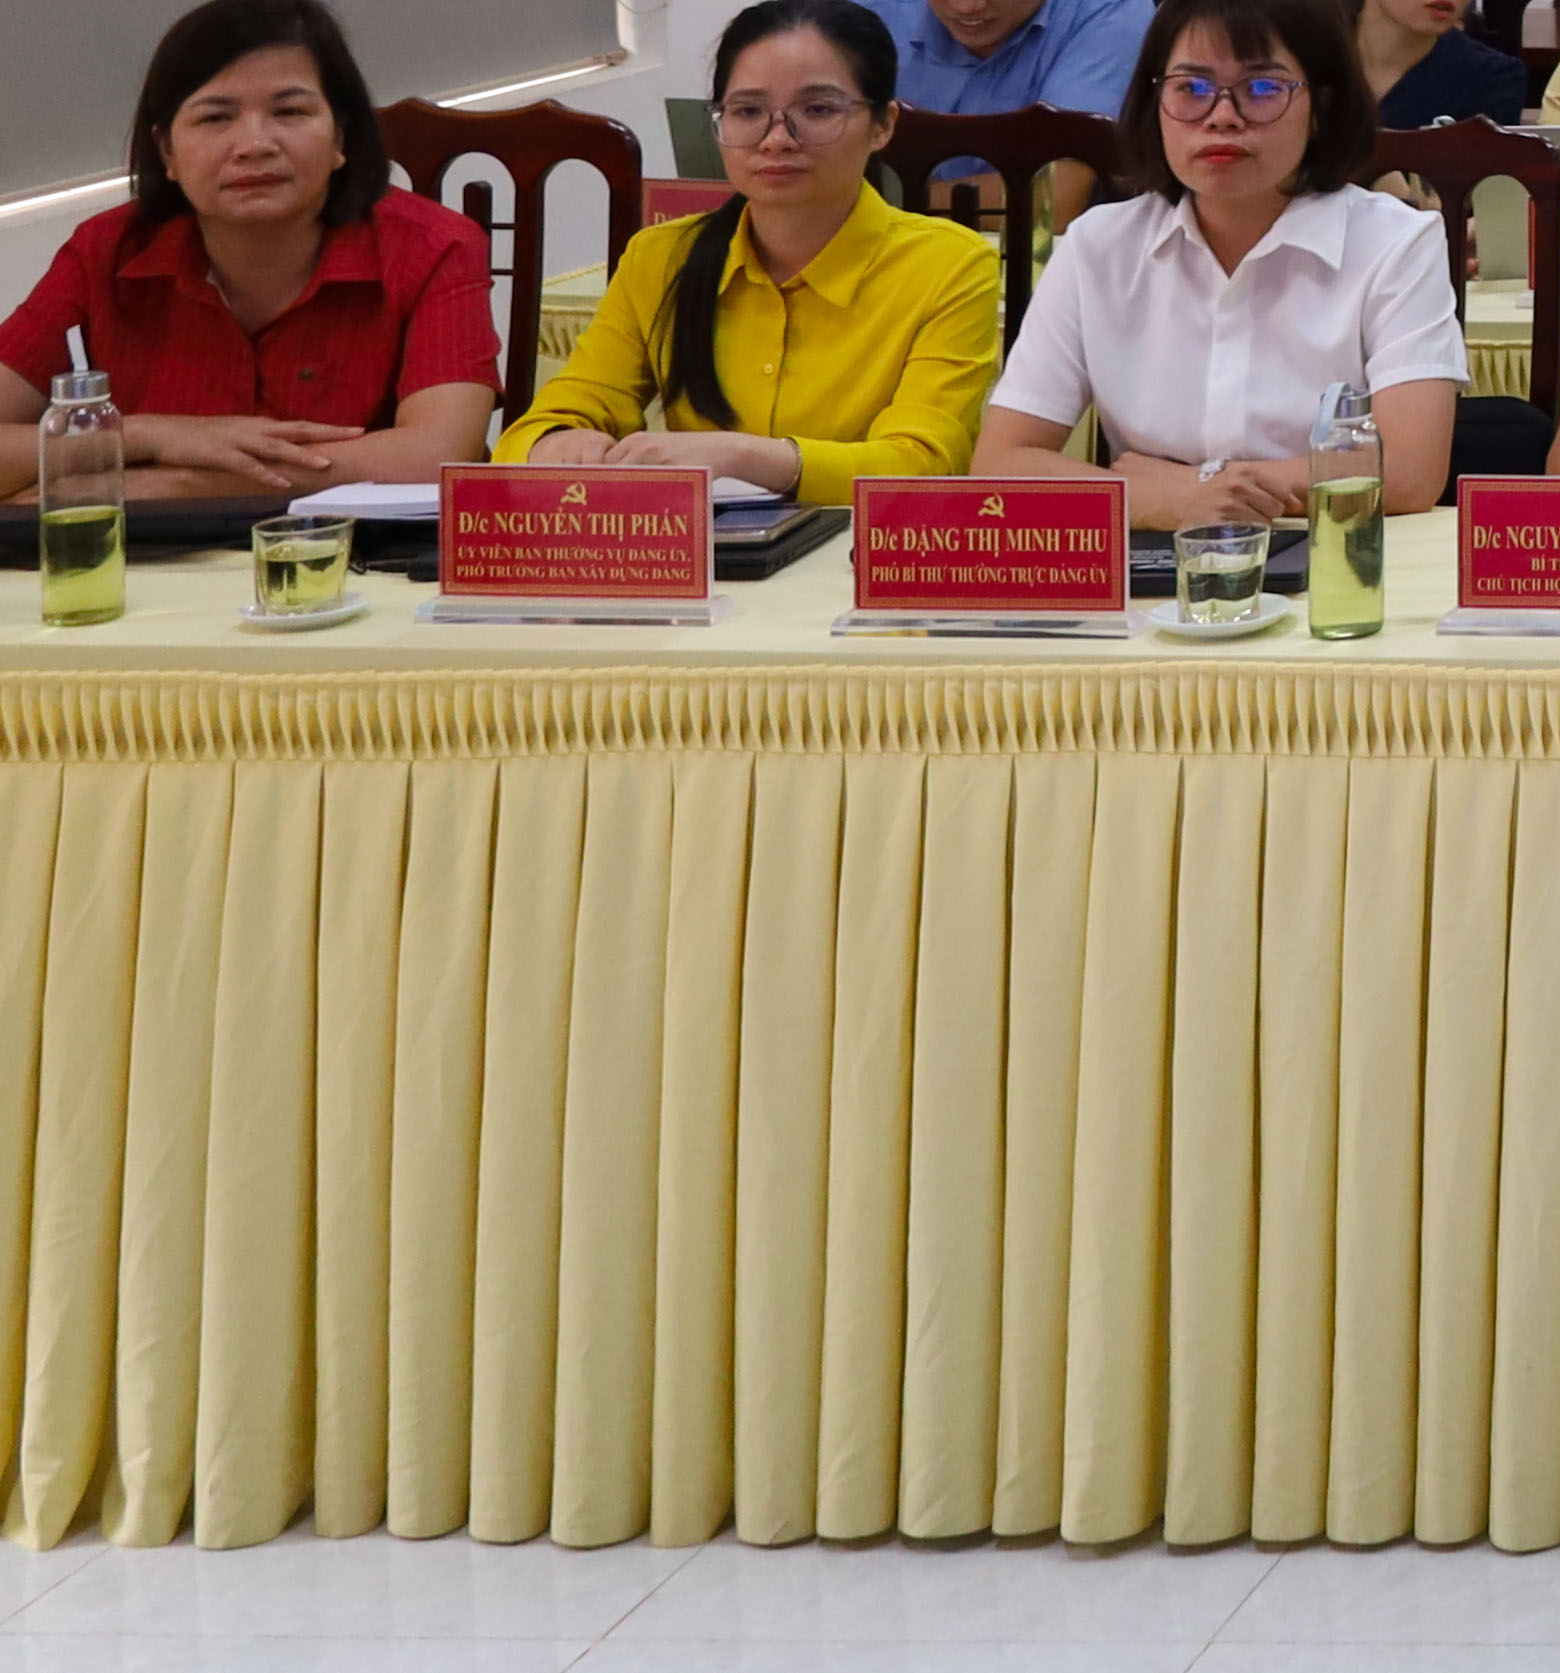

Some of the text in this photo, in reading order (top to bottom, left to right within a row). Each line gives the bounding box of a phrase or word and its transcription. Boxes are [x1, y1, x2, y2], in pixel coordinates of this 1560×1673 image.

[458, 511, 488, 535] Đ/c
[587, 513, 624, 542] THỊ
[1472, 525, 1501, 550] Đ/c
[870, 524, 1108, 558] Đ/c ĐẶNG THỊ MINH THU
[871, 561, 900, 582] PHÓ
[902, 561, 916, 582] BÍ
[919, 565, 948, 582] THƯ
[1009, 564, 1047, 588] TRỰC
[1049, 563, 1087, 583] ĐẢNG
[1090, 562, 1108, 584] ỦY
[1531, 554, 1545, 571] BÍ
[1477, 575, 1504, 591] CHỦ
[1510, 577, 1544, 594] TỊCH
